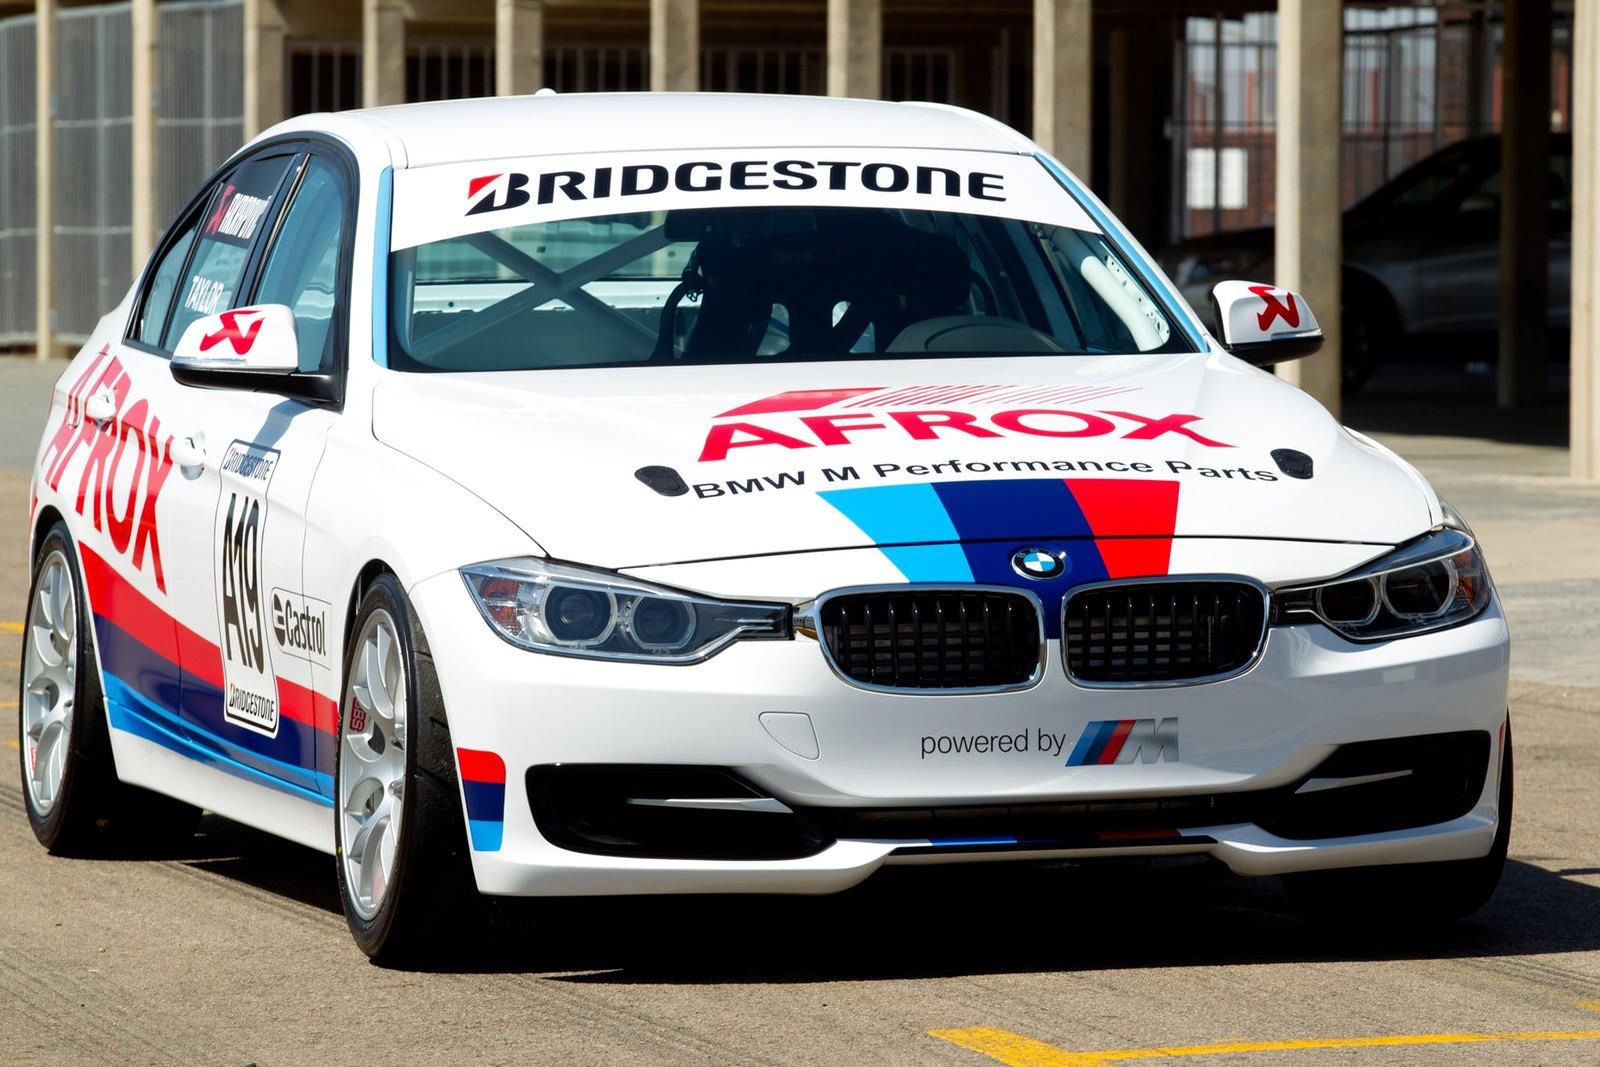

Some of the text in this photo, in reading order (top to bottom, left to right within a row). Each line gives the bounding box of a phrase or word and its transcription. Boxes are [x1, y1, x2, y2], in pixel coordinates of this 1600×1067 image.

[464, 160, 1006, 216] BRIDGESTONE
[184, 275, 224, 315] TAYLOR
[697, 409, 1239, 462] AFROX
[41, 343, 174, 595] AFROX
[222, 448, 274, 481] BRIDGESTONE
[693, 459, 1279, 499] BMW M Performance Parts
[222, 493, 264, 675] A19
[284, 600, 327, 657] Castrol
[229, 683, 275, 723] BRIDGESTONE
[921, 728, 1029, 759] powered
[1037, 727, 1067, 757] by
